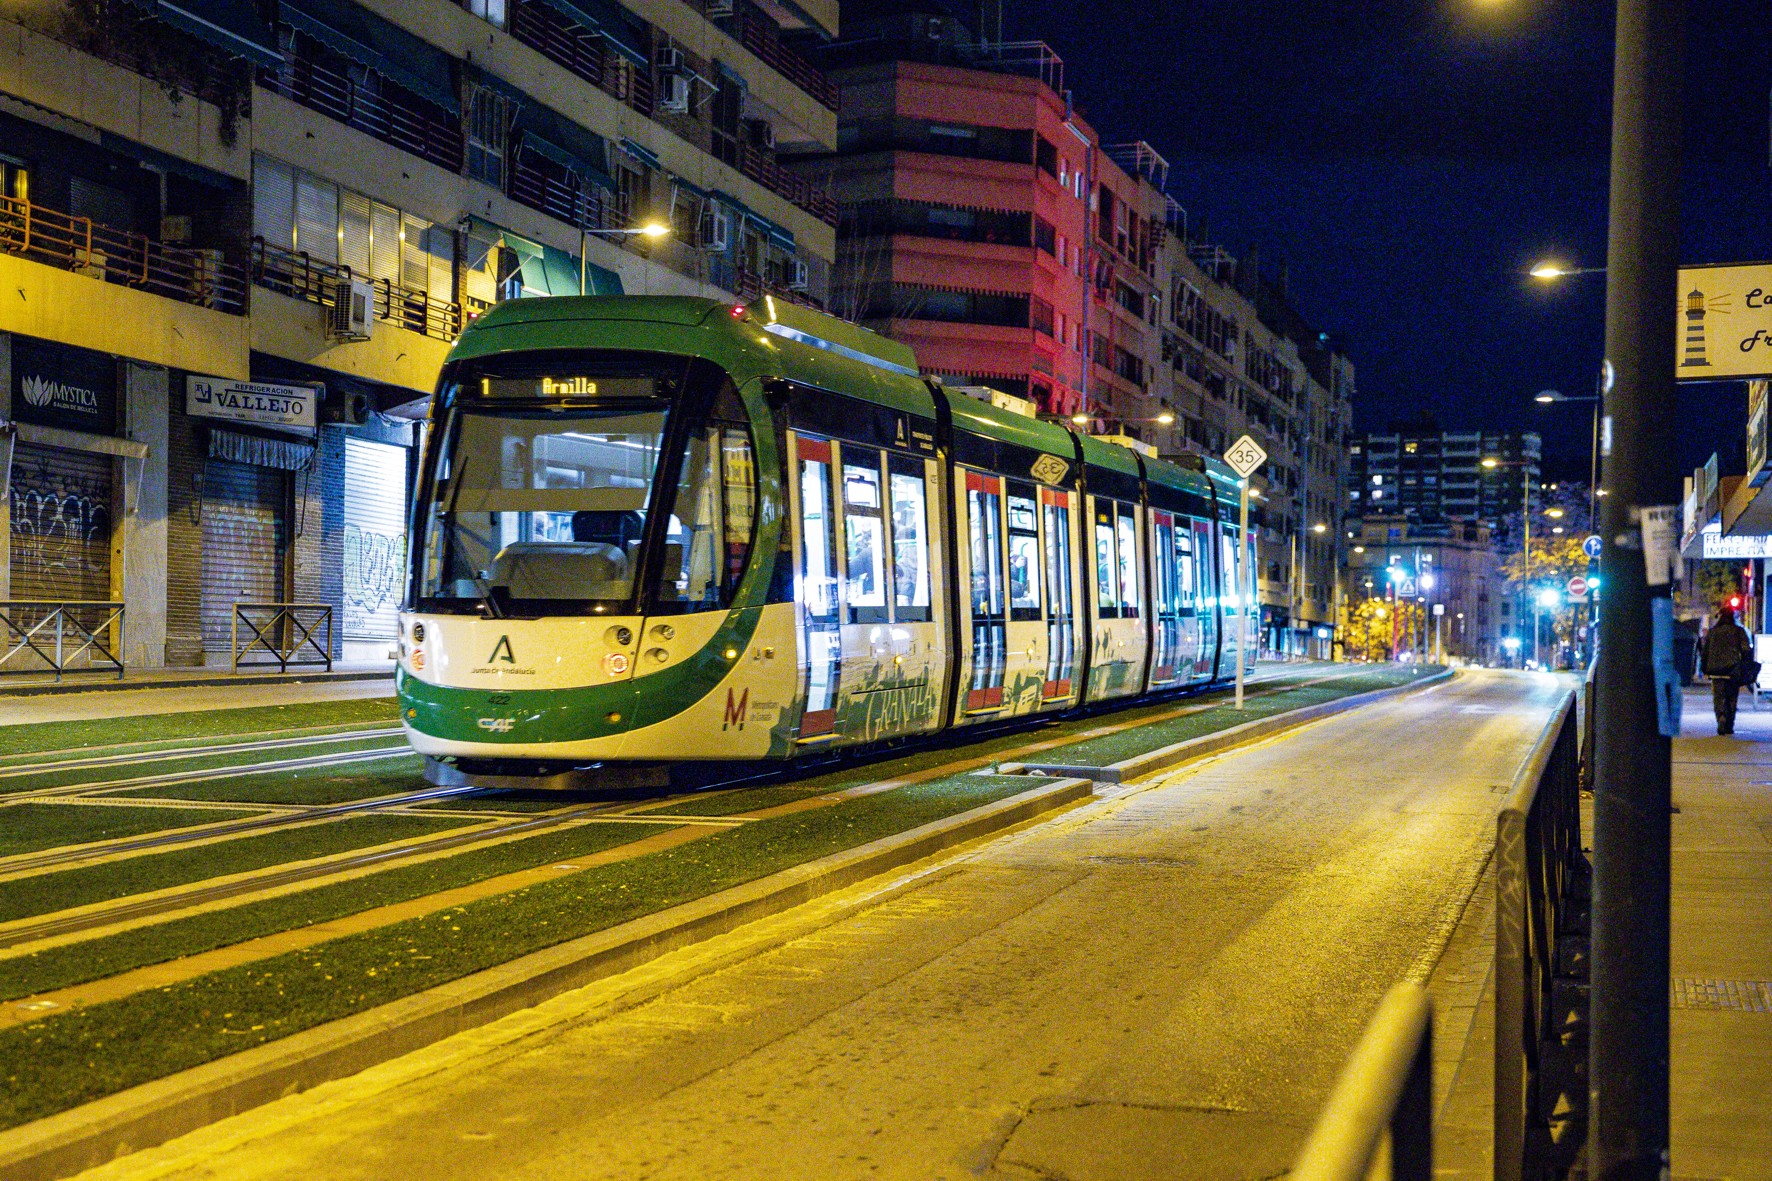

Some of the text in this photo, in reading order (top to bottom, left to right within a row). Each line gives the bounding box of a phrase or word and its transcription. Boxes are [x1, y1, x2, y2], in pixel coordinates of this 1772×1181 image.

[54, 381, 98, 407] MYSTICA
[481, 376, 597, 395] 1 Armilla
[215, 389, 304, 415] VALLEJO
[1235, 450, 1254, 464] 35
